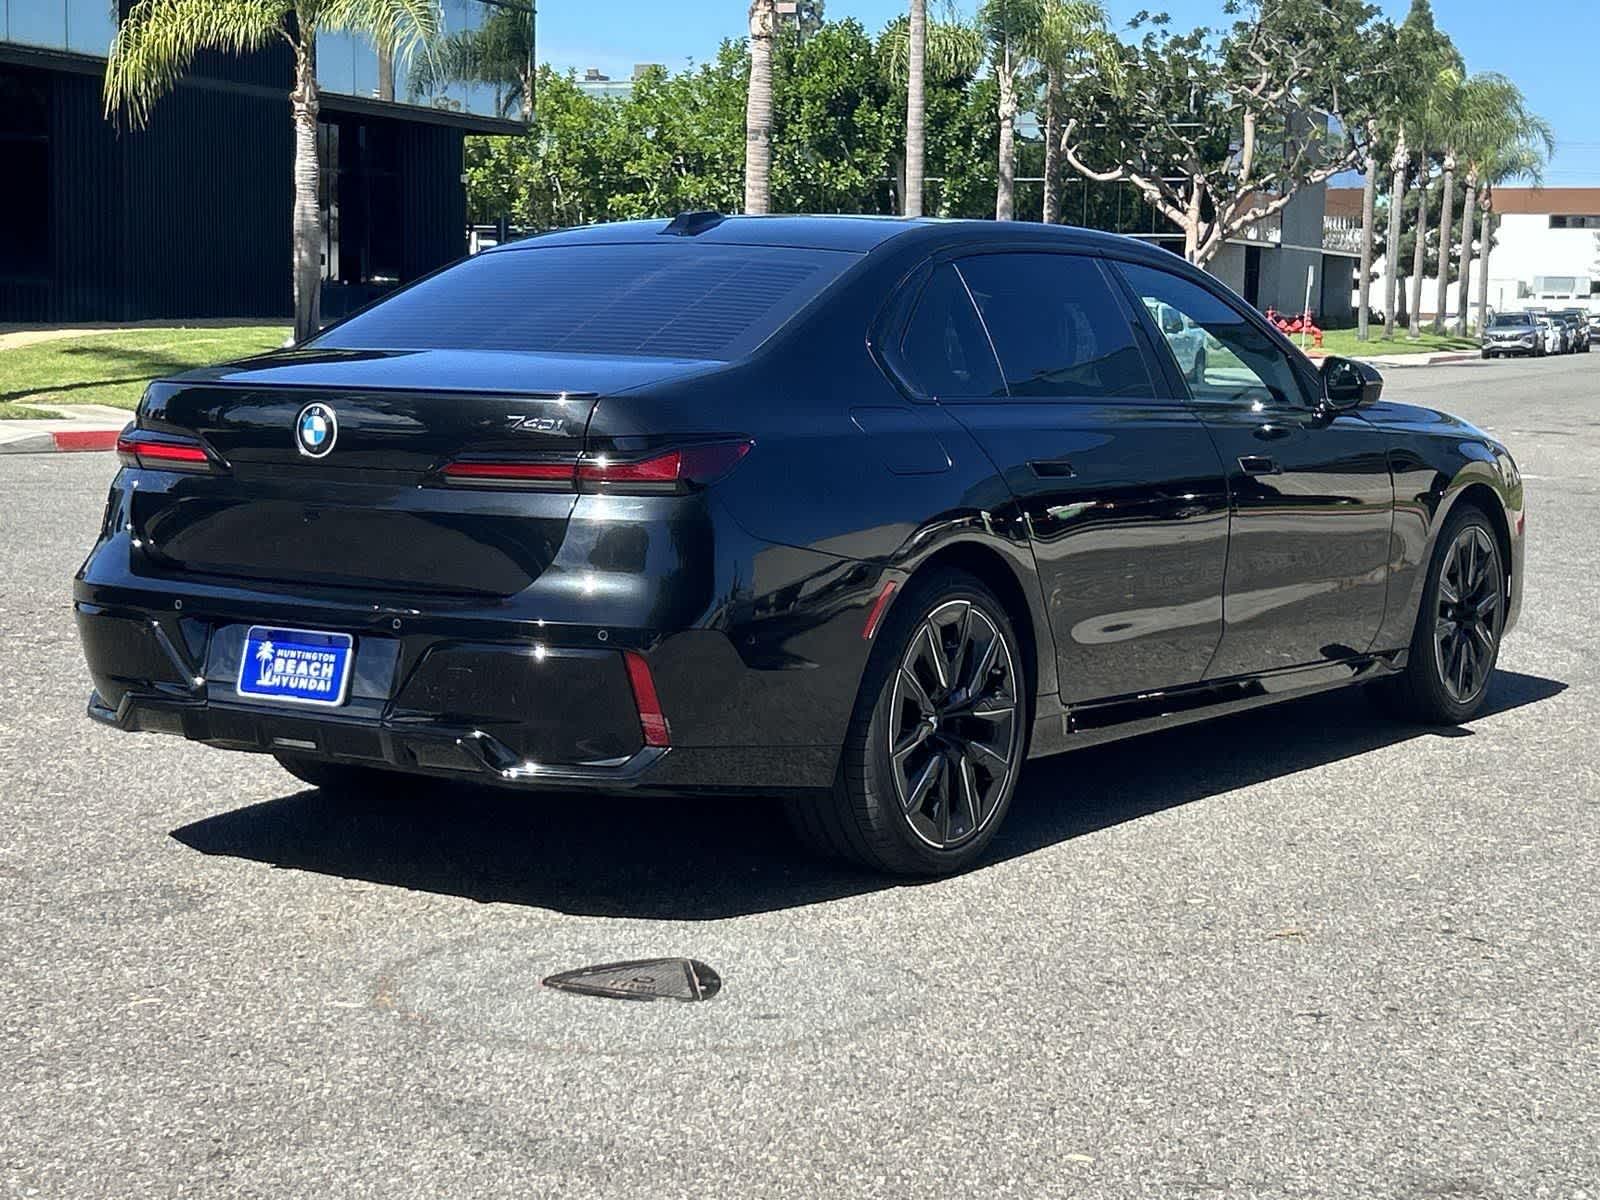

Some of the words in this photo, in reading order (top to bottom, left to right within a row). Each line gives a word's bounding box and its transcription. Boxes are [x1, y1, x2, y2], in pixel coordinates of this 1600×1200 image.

[276, 649, 336, 662] HUNTINGTON
[274, 658, 334, 678] BEACH
[271, 675, 331, 692] HYUNDAI
